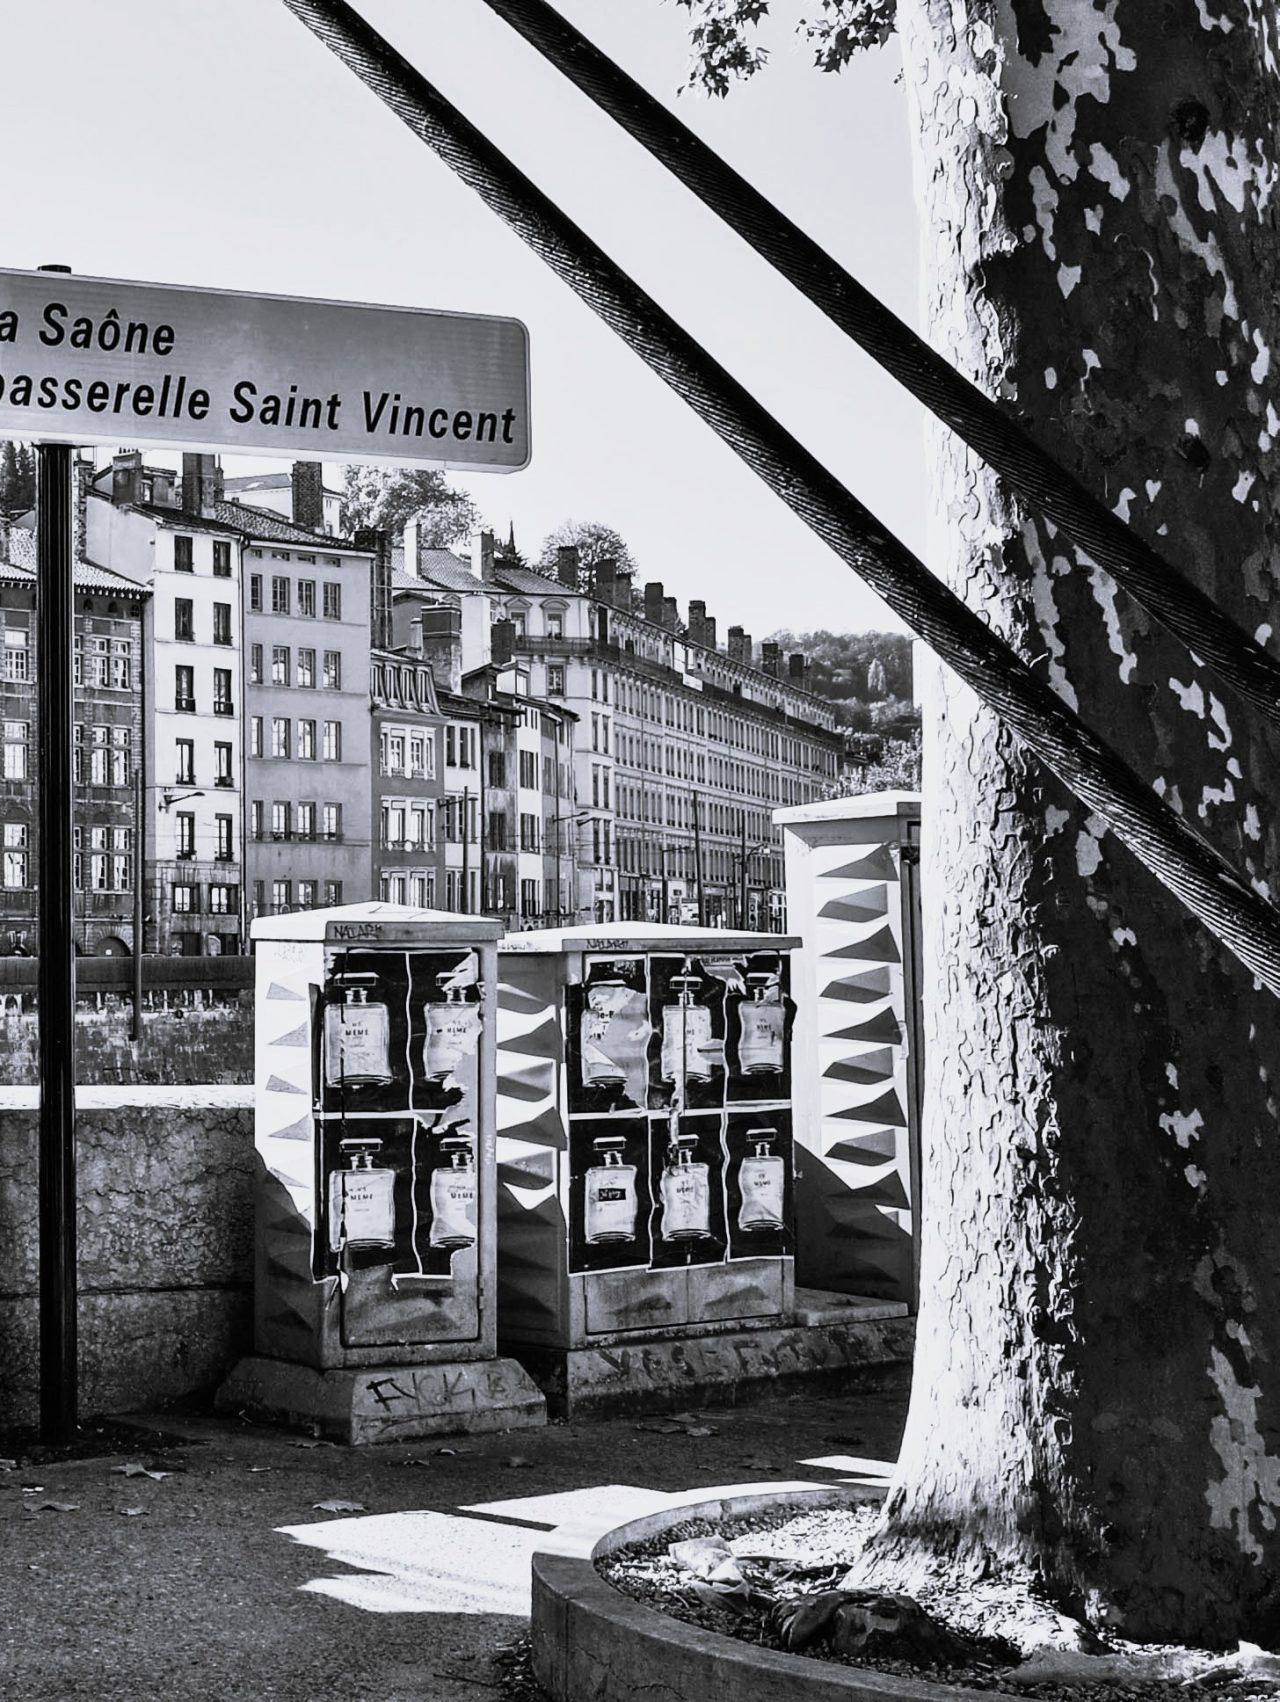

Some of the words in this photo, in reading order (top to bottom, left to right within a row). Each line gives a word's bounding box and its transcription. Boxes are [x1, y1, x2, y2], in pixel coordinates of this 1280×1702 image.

[39, 302, 177, 357] Saône
[229, 380, 343, 431] Saint
[362, 390, 518, 445] Vincent
